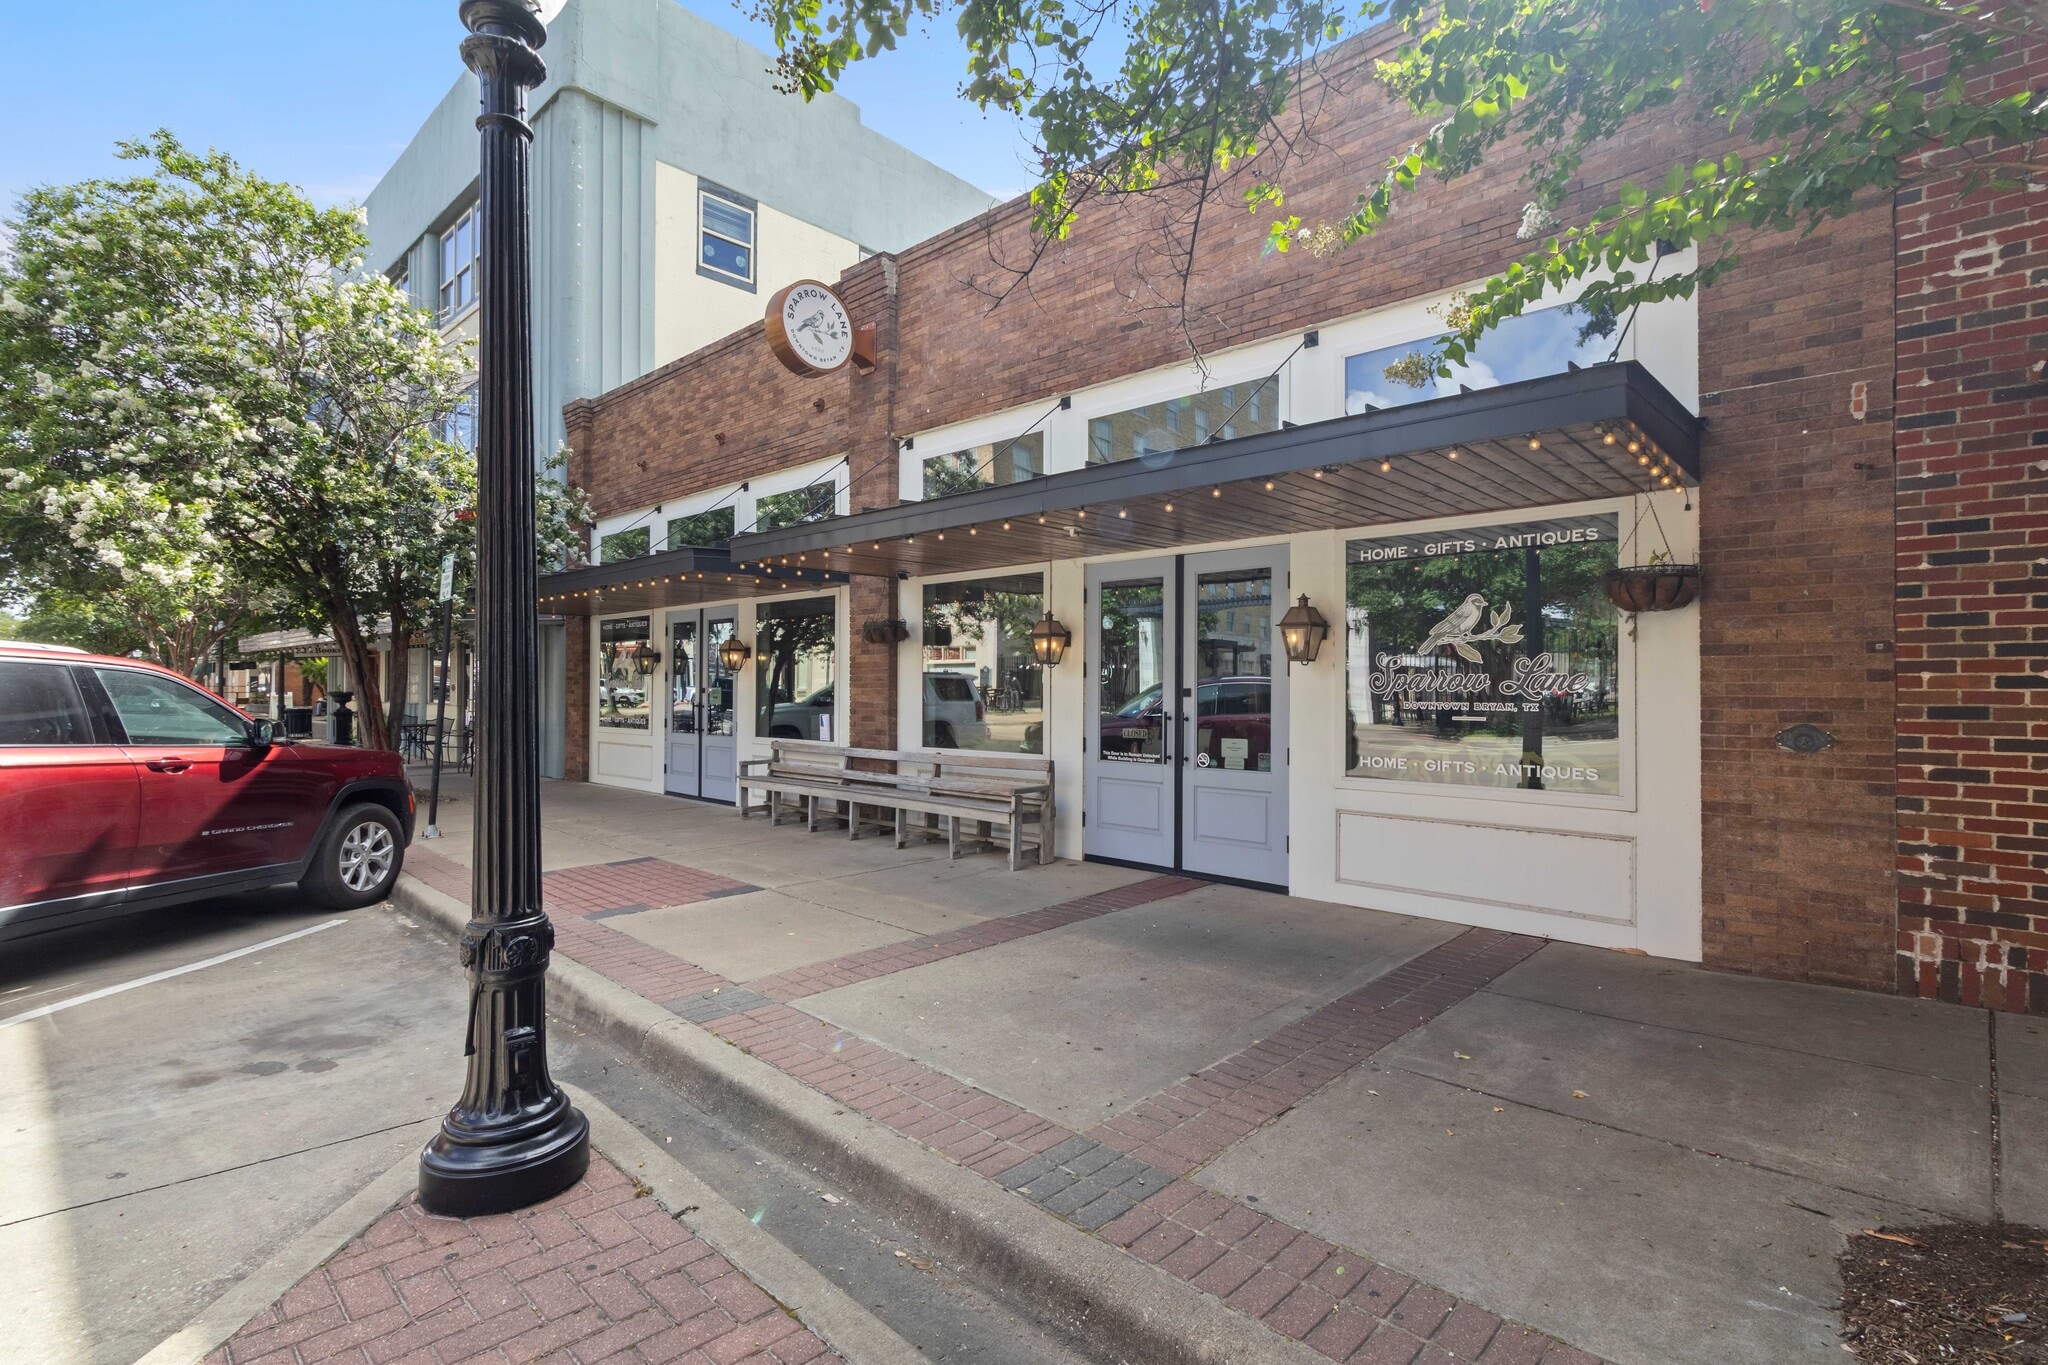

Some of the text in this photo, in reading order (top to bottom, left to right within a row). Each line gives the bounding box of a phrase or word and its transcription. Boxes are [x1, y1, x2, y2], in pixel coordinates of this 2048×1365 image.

[787, 289, 848, 338] SPARROW LANE
[791, 329, 817, 360] DOWNTOWN
[1360, 528, 1599, 561] HOME GIFTS ANTIQUES
[1368, 652, 1589, 700] Sparrow Lane
[1404, 701, 1540, 712] DOWNTOWN BRYAN, TX
[1123, 730, 1147, 738] CLOSED
[1360, 757, 1599, 780] HOME GIFTS ANTIQUES
[211, 826, 245, 835] GRAND
